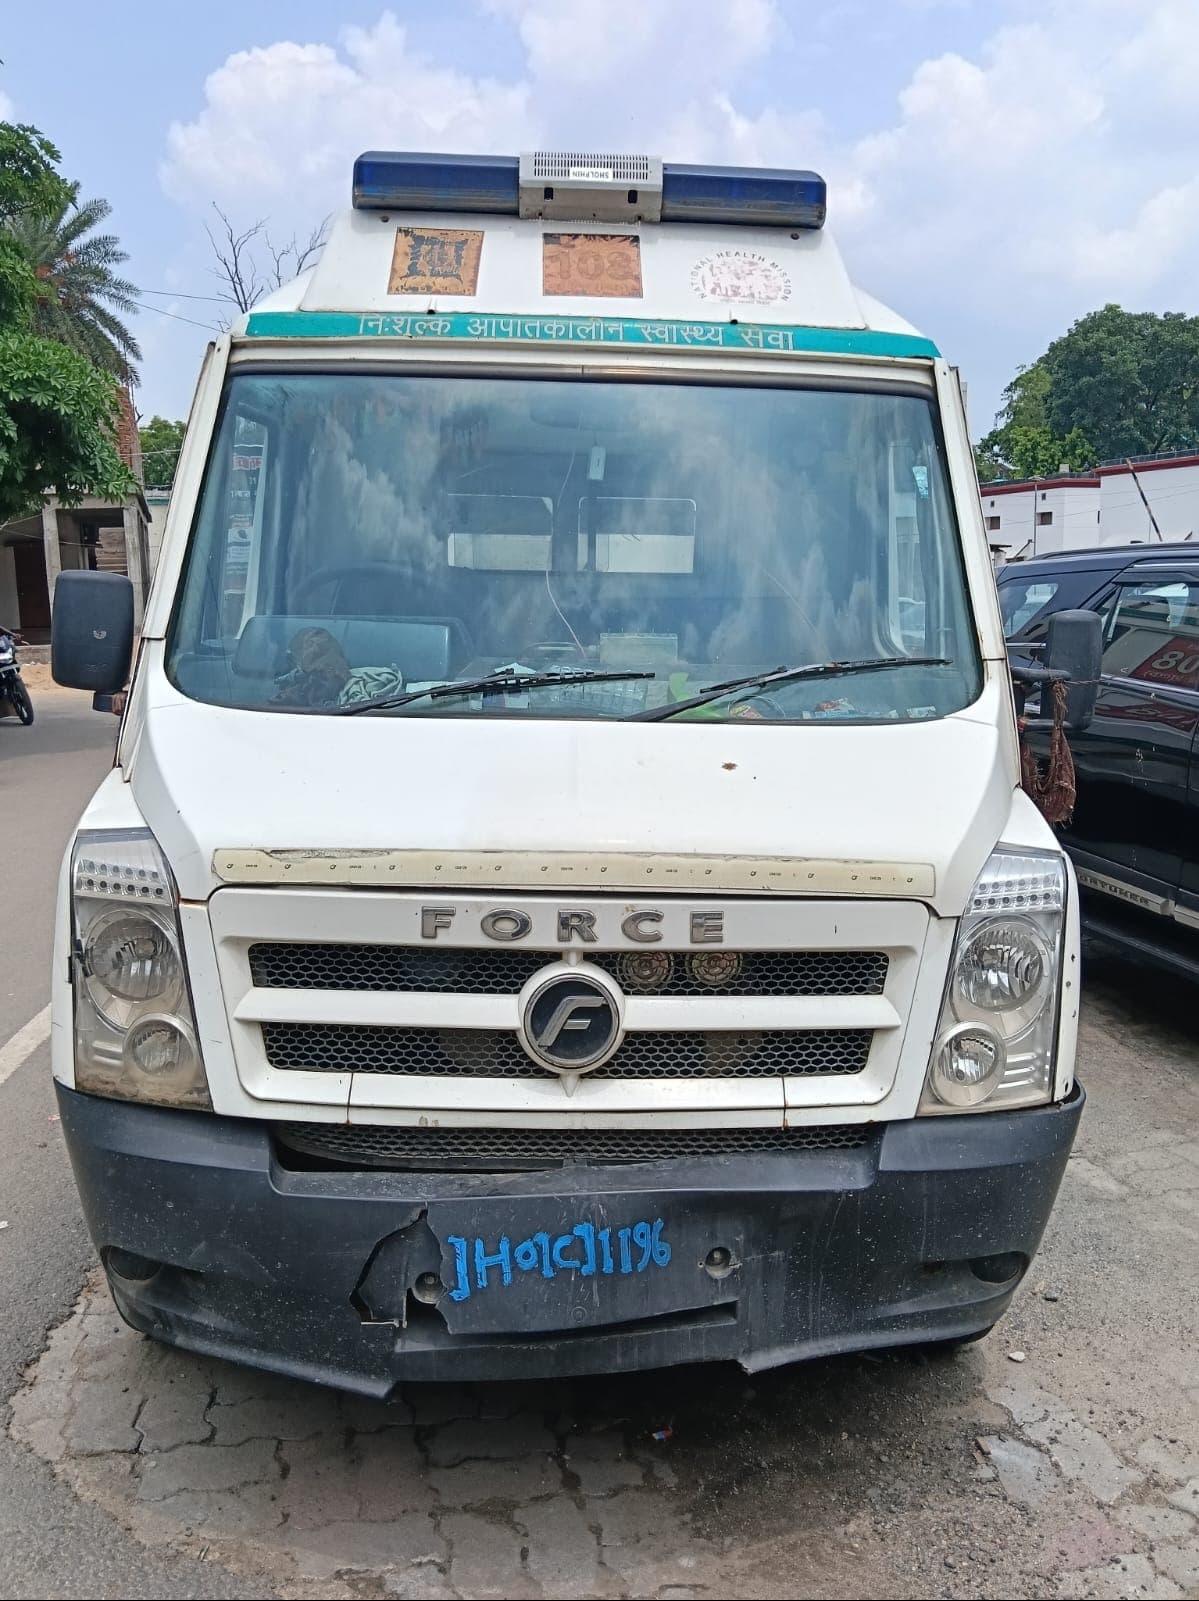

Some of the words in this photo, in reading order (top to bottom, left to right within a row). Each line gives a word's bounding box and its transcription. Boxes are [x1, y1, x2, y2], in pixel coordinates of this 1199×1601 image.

[716, 251, 765, 262] HEALTH
[467, 316, 624, 341] आपातकालीन
[638, 322, 723, 346] स्वास्थ्य
[738, 325, 793, 350] सेवा
[421, 906, 724, 943] FORCE
